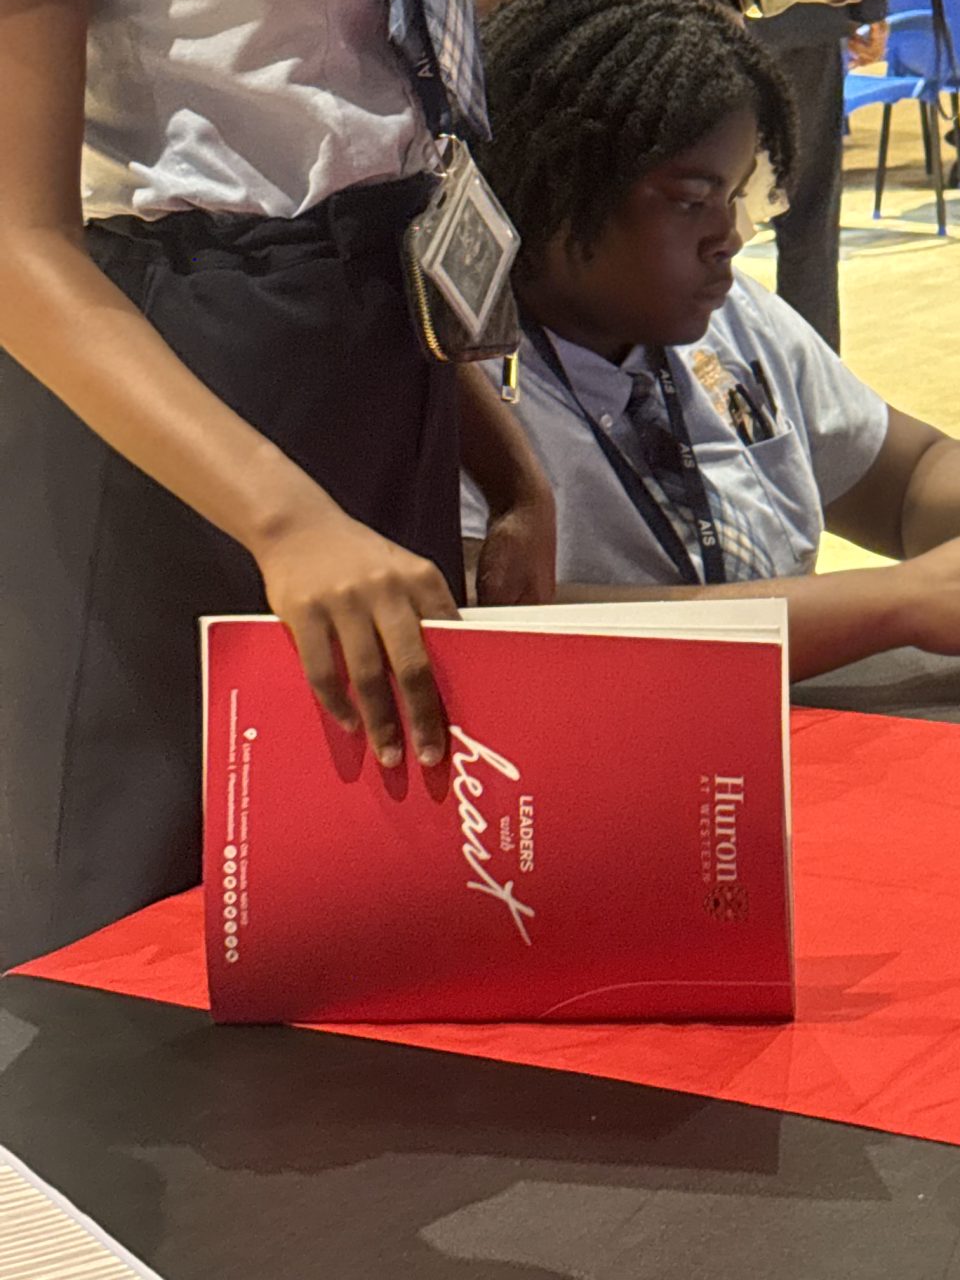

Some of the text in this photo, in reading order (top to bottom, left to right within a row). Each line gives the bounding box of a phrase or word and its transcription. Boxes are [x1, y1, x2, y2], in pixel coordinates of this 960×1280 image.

[659, 368, 677, 396] AIS
[679, 441, 696, 469] AIS
[699, 519, 717, 547] AIS
[448, 724, 536, 947] heart
[499, 815, 516, 852] with
[519, 795, 535, 873] LEADERS
[699, 775, 712, 883] AT WESTERN
[714, 773, 745, 882] Huron
